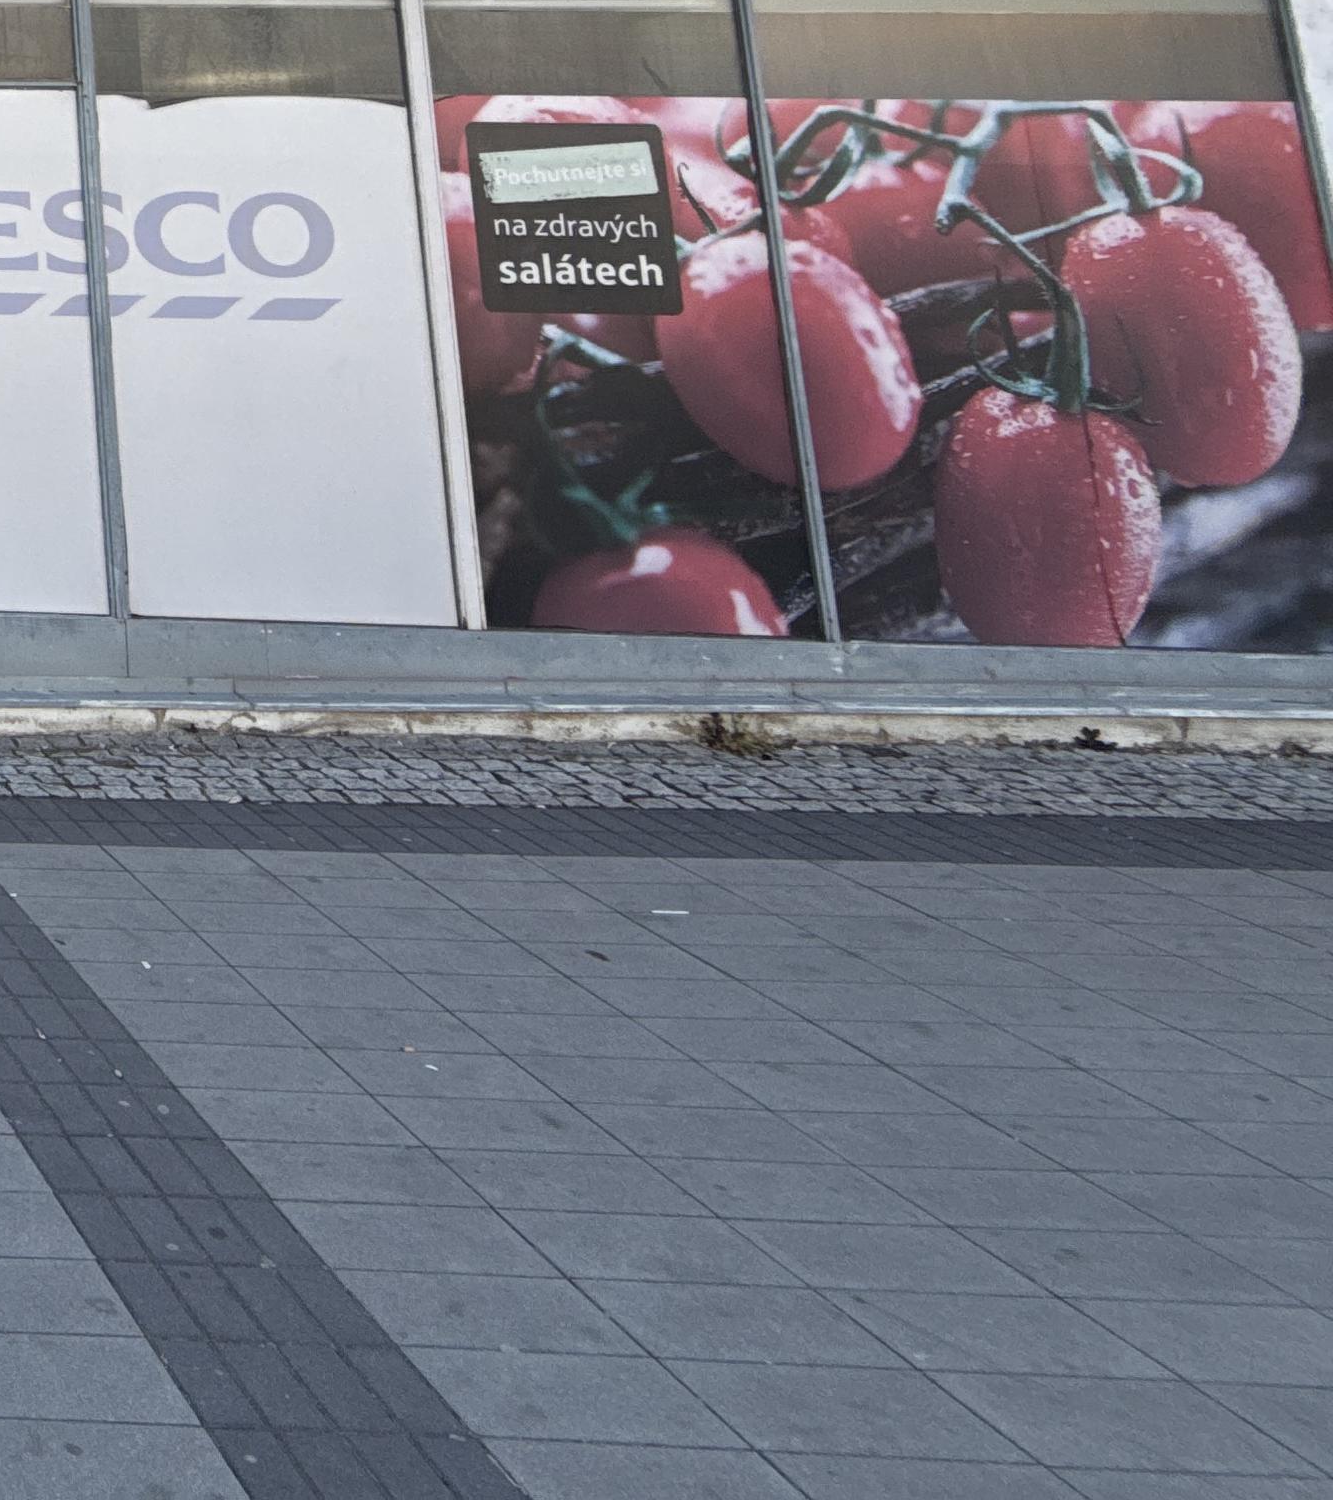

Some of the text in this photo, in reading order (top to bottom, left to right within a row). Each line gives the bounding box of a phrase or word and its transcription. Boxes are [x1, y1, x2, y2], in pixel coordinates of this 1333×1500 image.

[495, 164, 625, 186] Pochutnejte
[493, 213, 658, 243] na zdravých
[499, 253, 664, 287] salátech
